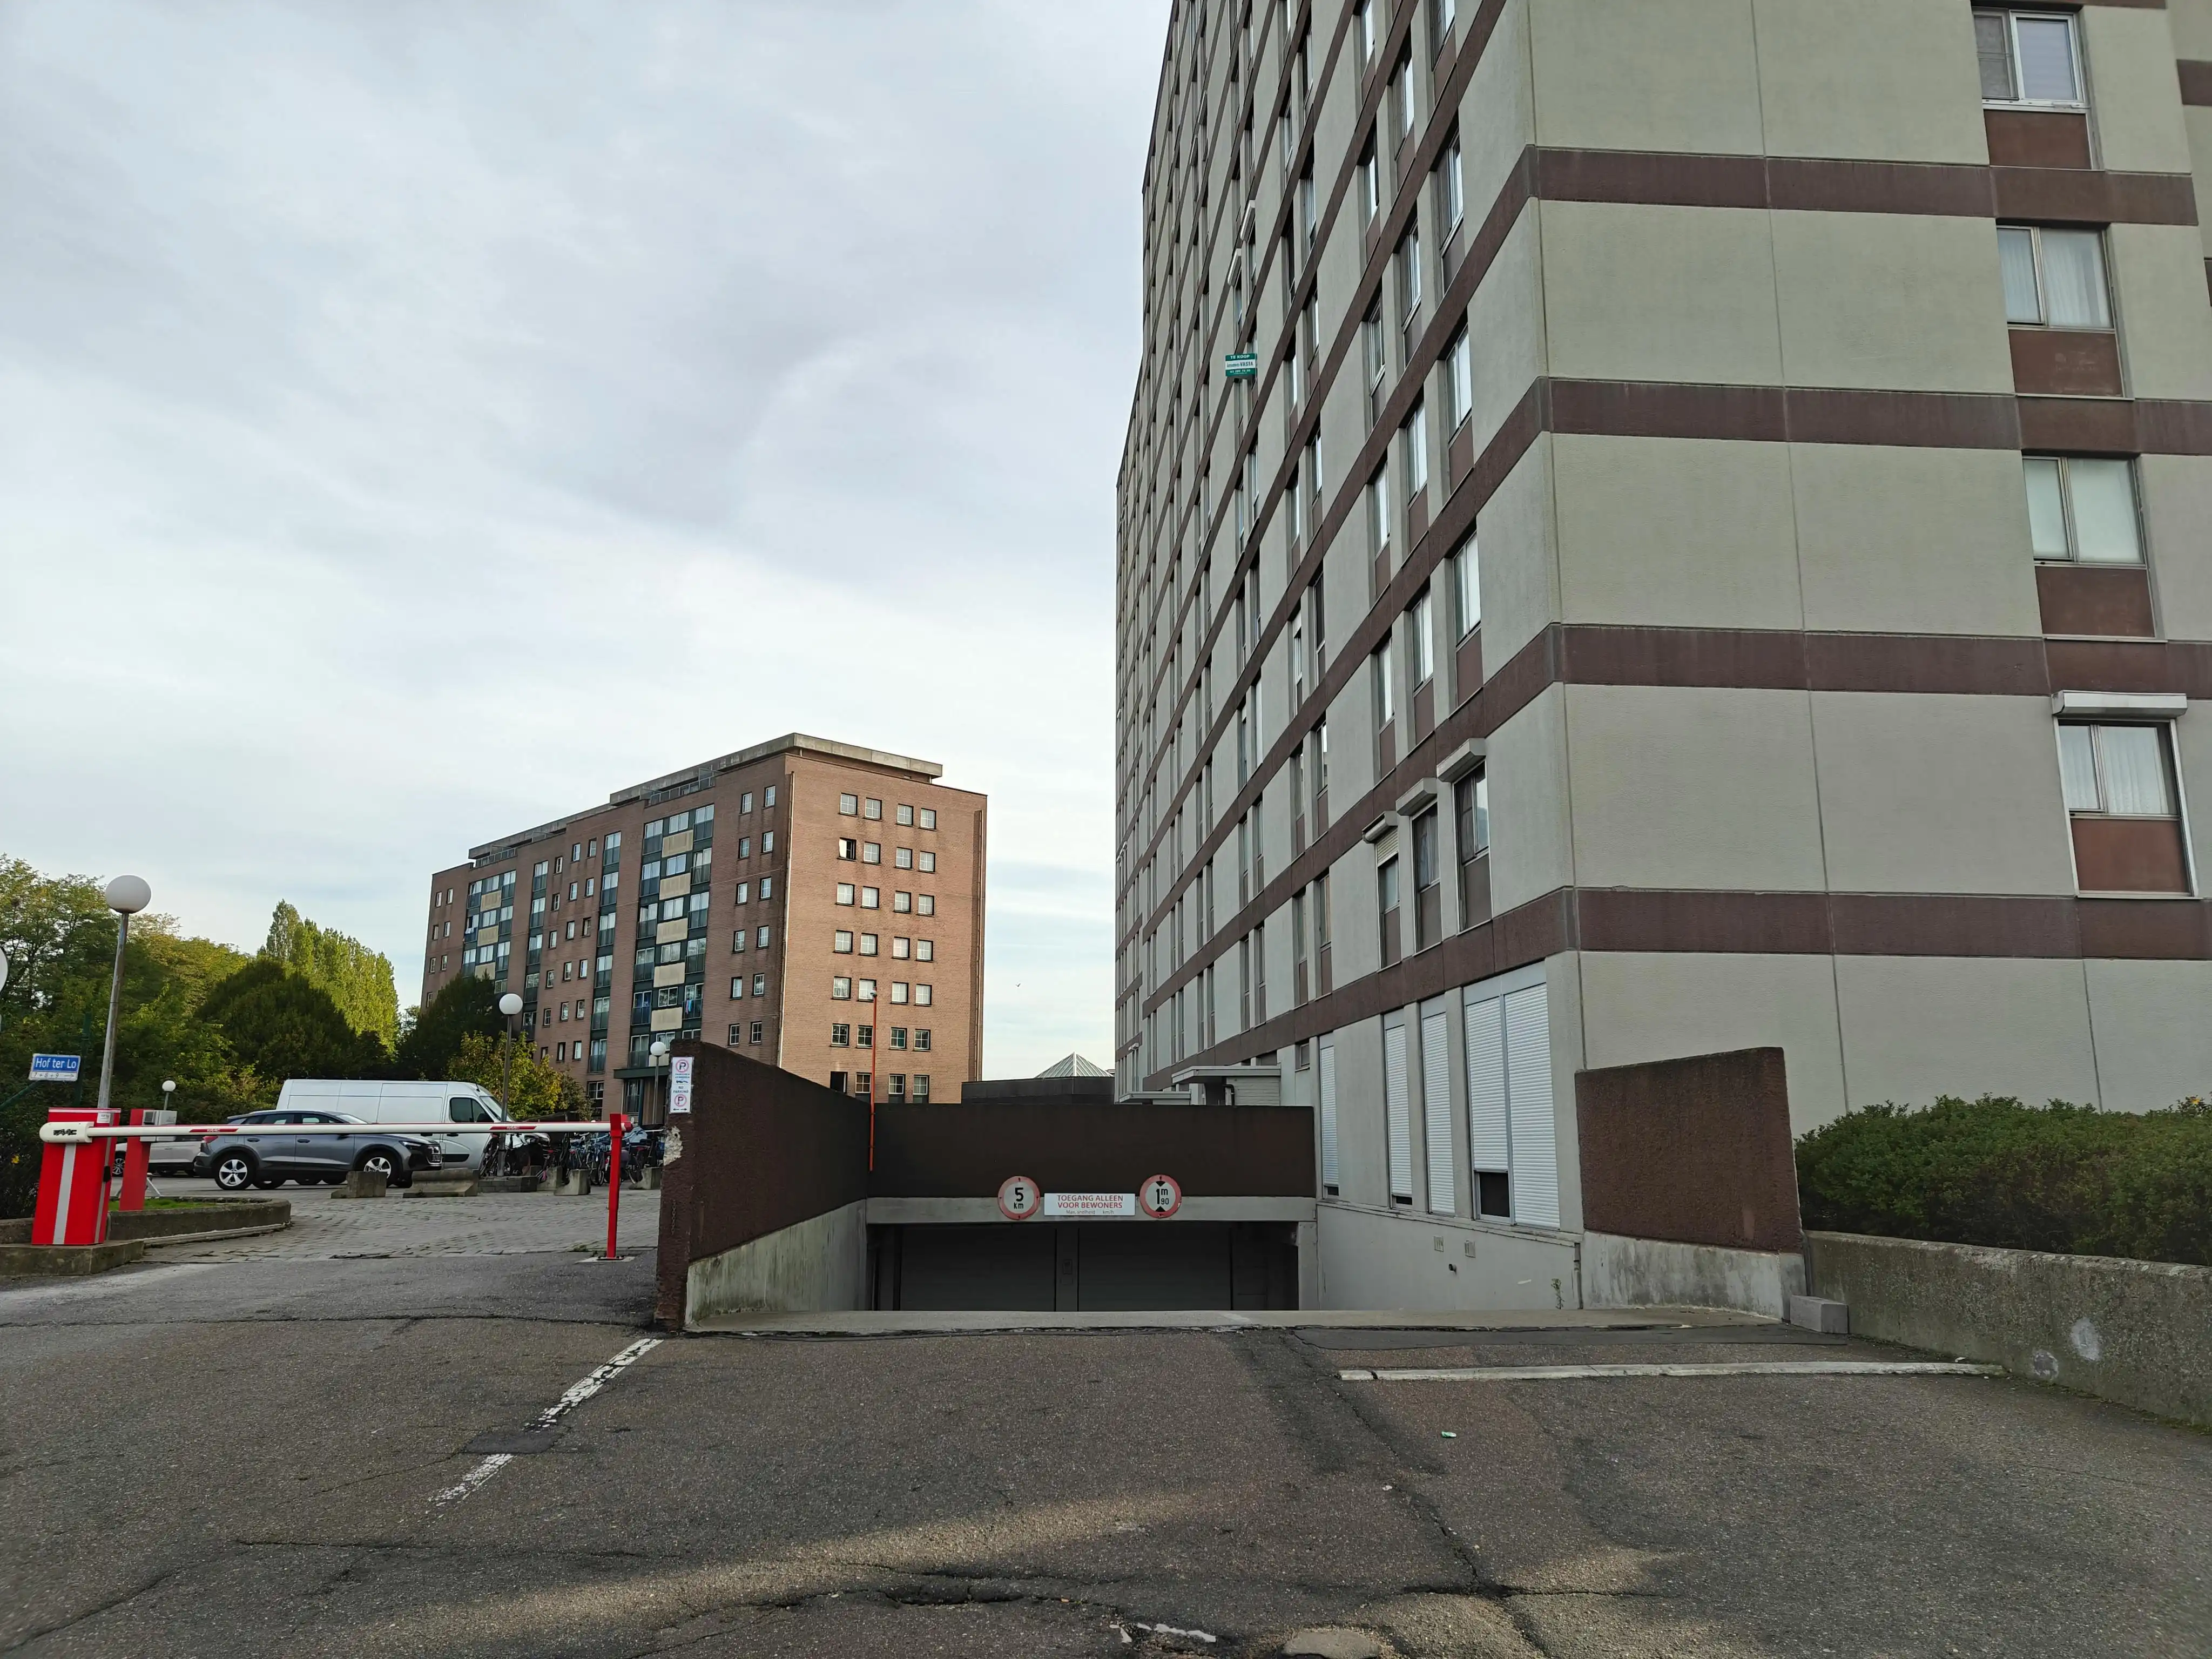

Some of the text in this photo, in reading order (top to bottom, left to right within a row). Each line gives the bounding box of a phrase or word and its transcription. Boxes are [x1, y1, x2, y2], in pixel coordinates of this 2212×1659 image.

[35, 1057, 77, 1068] Hof ter Lo
[1015, 1187, 1024, 1202] 5
